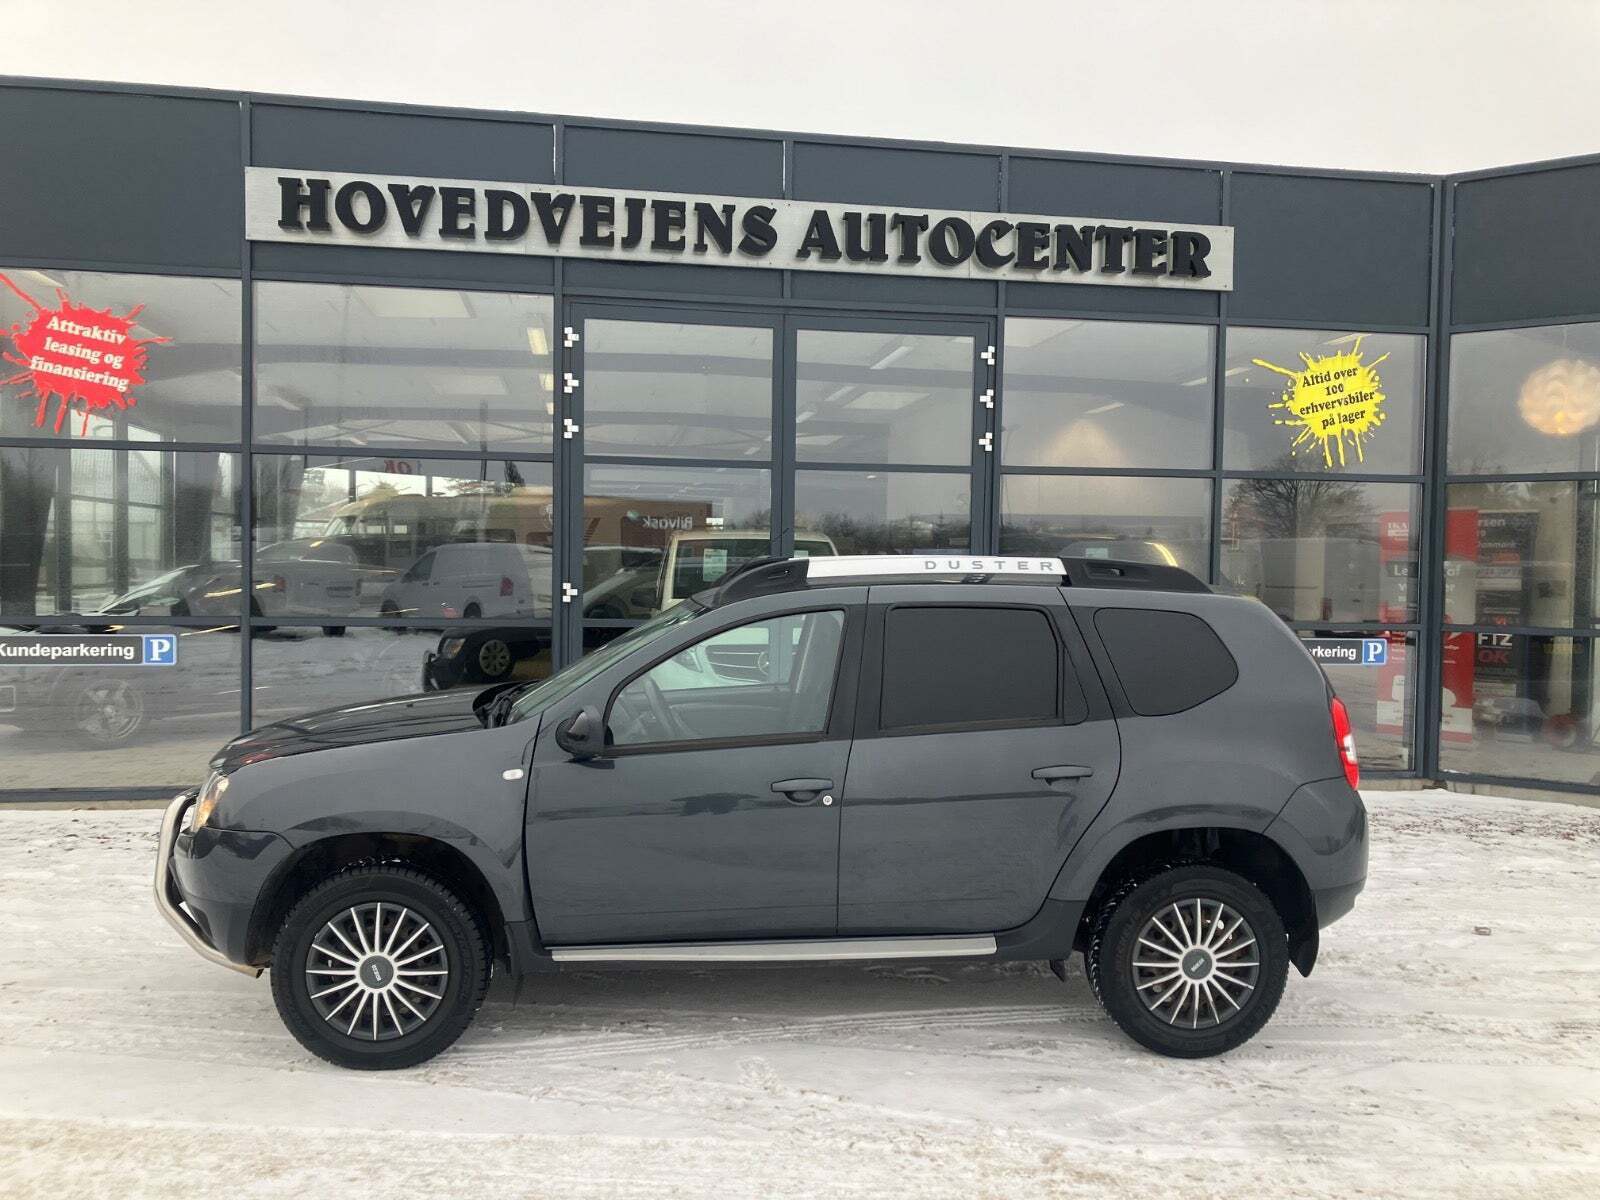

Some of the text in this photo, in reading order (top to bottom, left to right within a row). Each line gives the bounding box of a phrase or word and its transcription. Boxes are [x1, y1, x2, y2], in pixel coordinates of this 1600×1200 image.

[277, 176, 1213, 279] HOVEDVEJENS AUTOCENTER
[47, 316, 126, 344] Attraktiv
[44, 337, 125, 369] leasing og
[29, 356, 129, 391] finansiering
[1301, 367, 1359, 388] Altid over
[1325, 383, 1345, 396] 100
[1299, 389, 1376, 416] erhvervsbiler
[1321, 409, 1366, 430] på lager
[925, 560, 1054, 571] DUSTER
[0, 639, 171, 660] Kundeparkering P
[1477, 633, 1513, 646] FTZ
[1308, 645, 1357, 661] rkering
[1367, 642, 1383, 662] P
